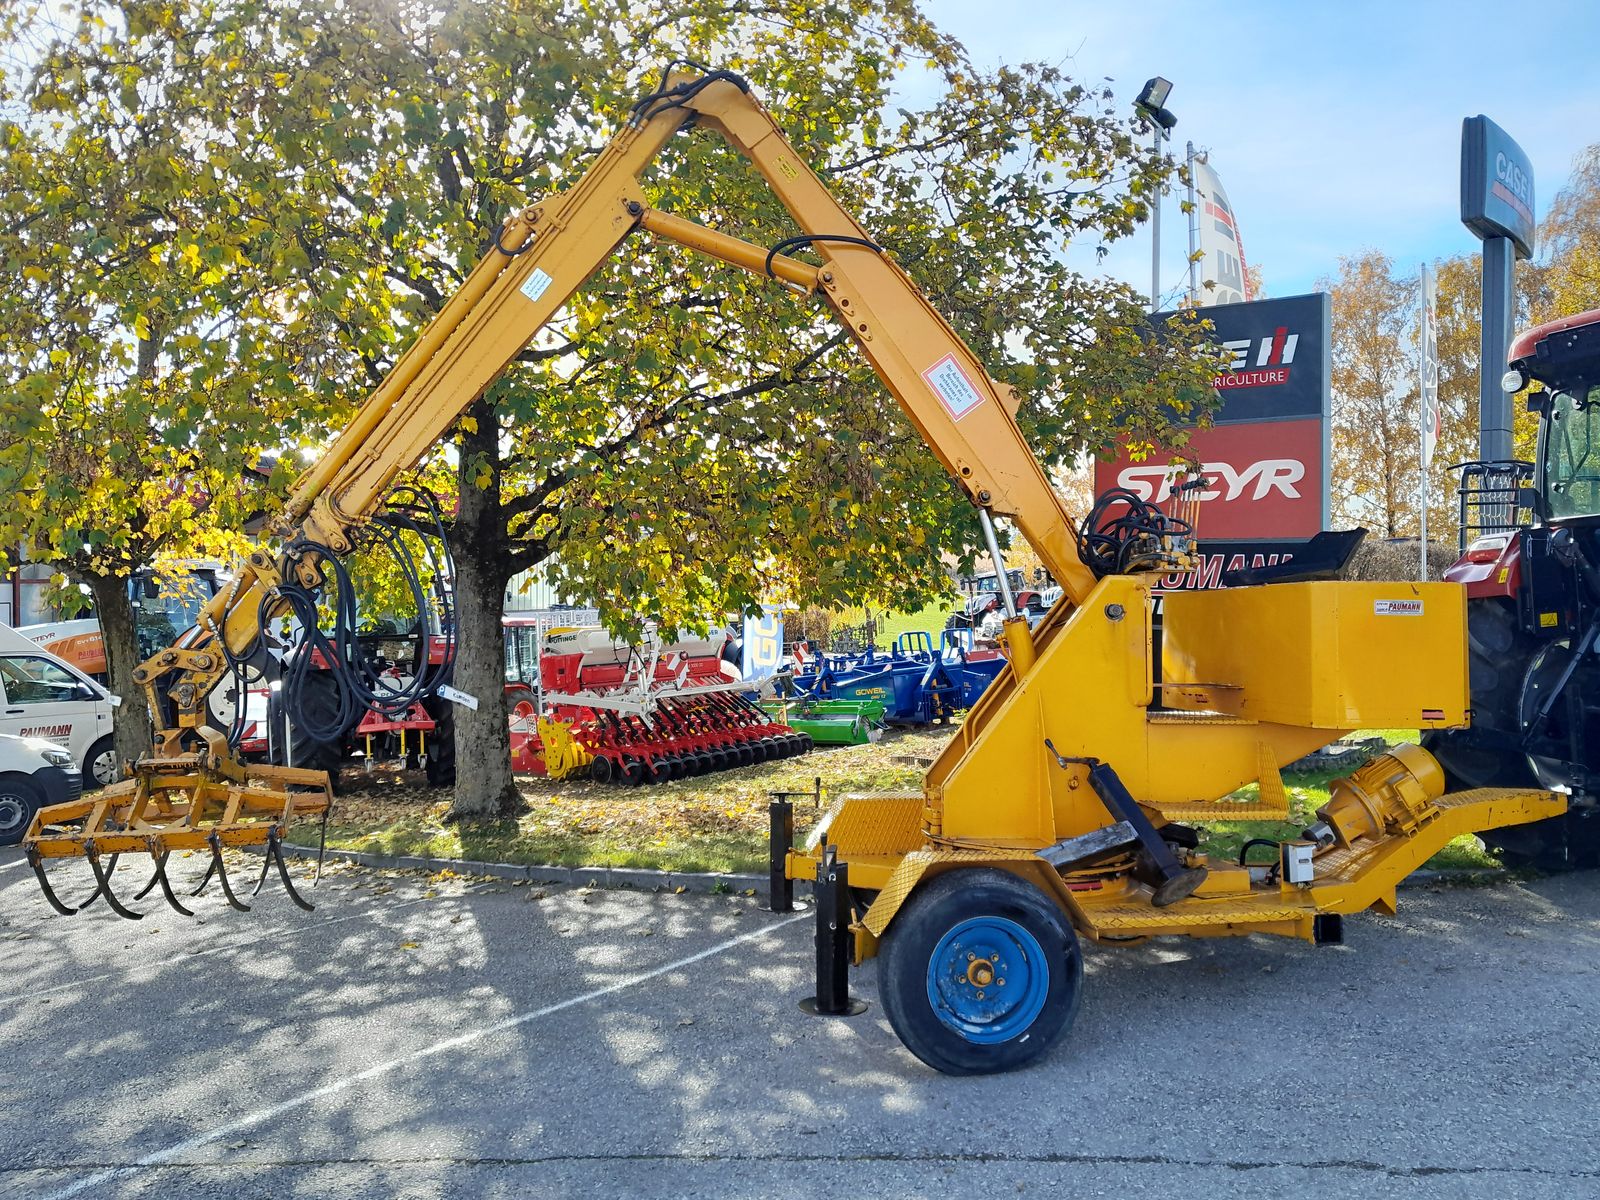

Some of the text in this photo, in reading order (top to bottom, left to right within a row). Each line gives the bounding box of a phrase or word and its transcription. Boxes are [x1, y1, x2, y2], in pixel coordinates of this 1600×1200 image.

[1495, 151, 1529, 199] CASE
[1211, 371, 1285, 387] RICULTURE
[1111, 459, 1305, 504] STEYR
[1388, 602, 1421, 611] PAUMANN
[20, 724, 72, 737] PAUMANN
